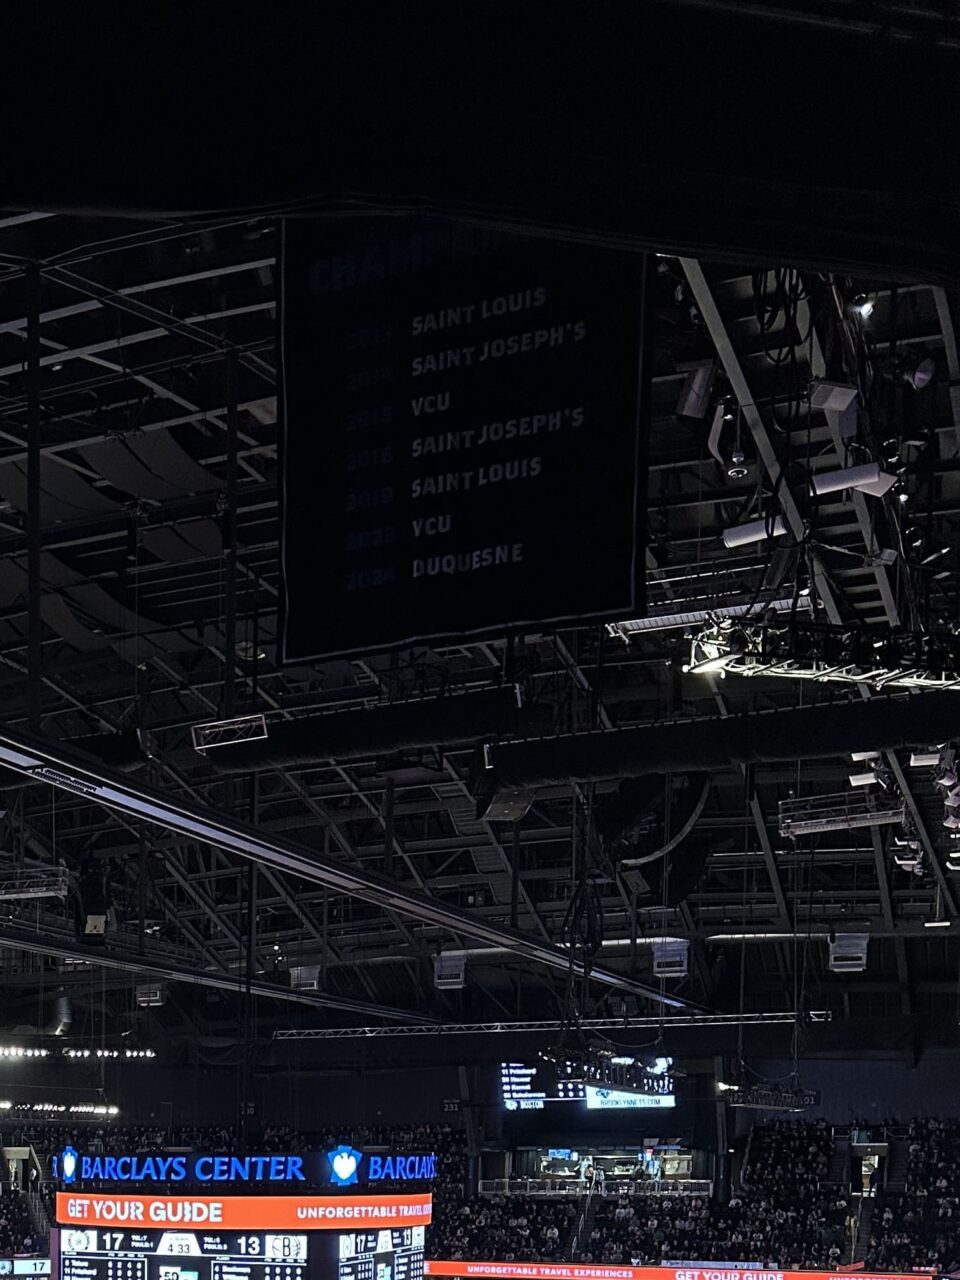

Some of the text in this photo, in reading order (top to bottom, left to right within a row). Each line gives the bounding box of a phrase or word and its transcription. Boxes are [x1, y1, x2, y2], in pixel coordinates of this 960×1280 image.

[412, 287, 547, 336] SAINT LOUIS
[412, 321, 587, 377] SAINT JOSEPH'S
[411, 392, 451, 417] VCU
[412, 407, 585, 458] SAINT JOSEPH'S
[411, 472, 474, 499] SAINT
[478, 457, 543, 486] LOUIS
[412, 514, 452, 537] VCU
[412, 544, 524, 578] DUQUESNE
[443, 1104, 458, 1112] 231
[520, 1101, 544, 1109] BOSTON
[81, 1156, 306, 1181] BARCLAYS CENTER
[369, 1156, 437, 1181] BARCLAYS
[68, 1199, 223, 1223] GET YOUR GUIDE
[297, 1206, 397, 1219] UNFORGETTABLE
[399, 1204, 423, 1217] TRAVEL
[102, 1232, 124, 1250] 17
[237, 1236, 260, 1254] 13
[282, 1236, 291, 1257] B
[356, 1235, 366, 1252] 17
[403, 1229, 412, 1246] 13
[32, 1262, 45, 1272] 17
[467, 1265, 538, 1277] UNFORGETTABLE
[540, 1266, 572, 1278] TRAVEL
[574, 1268, 634, 1279] EXPERIENCES
